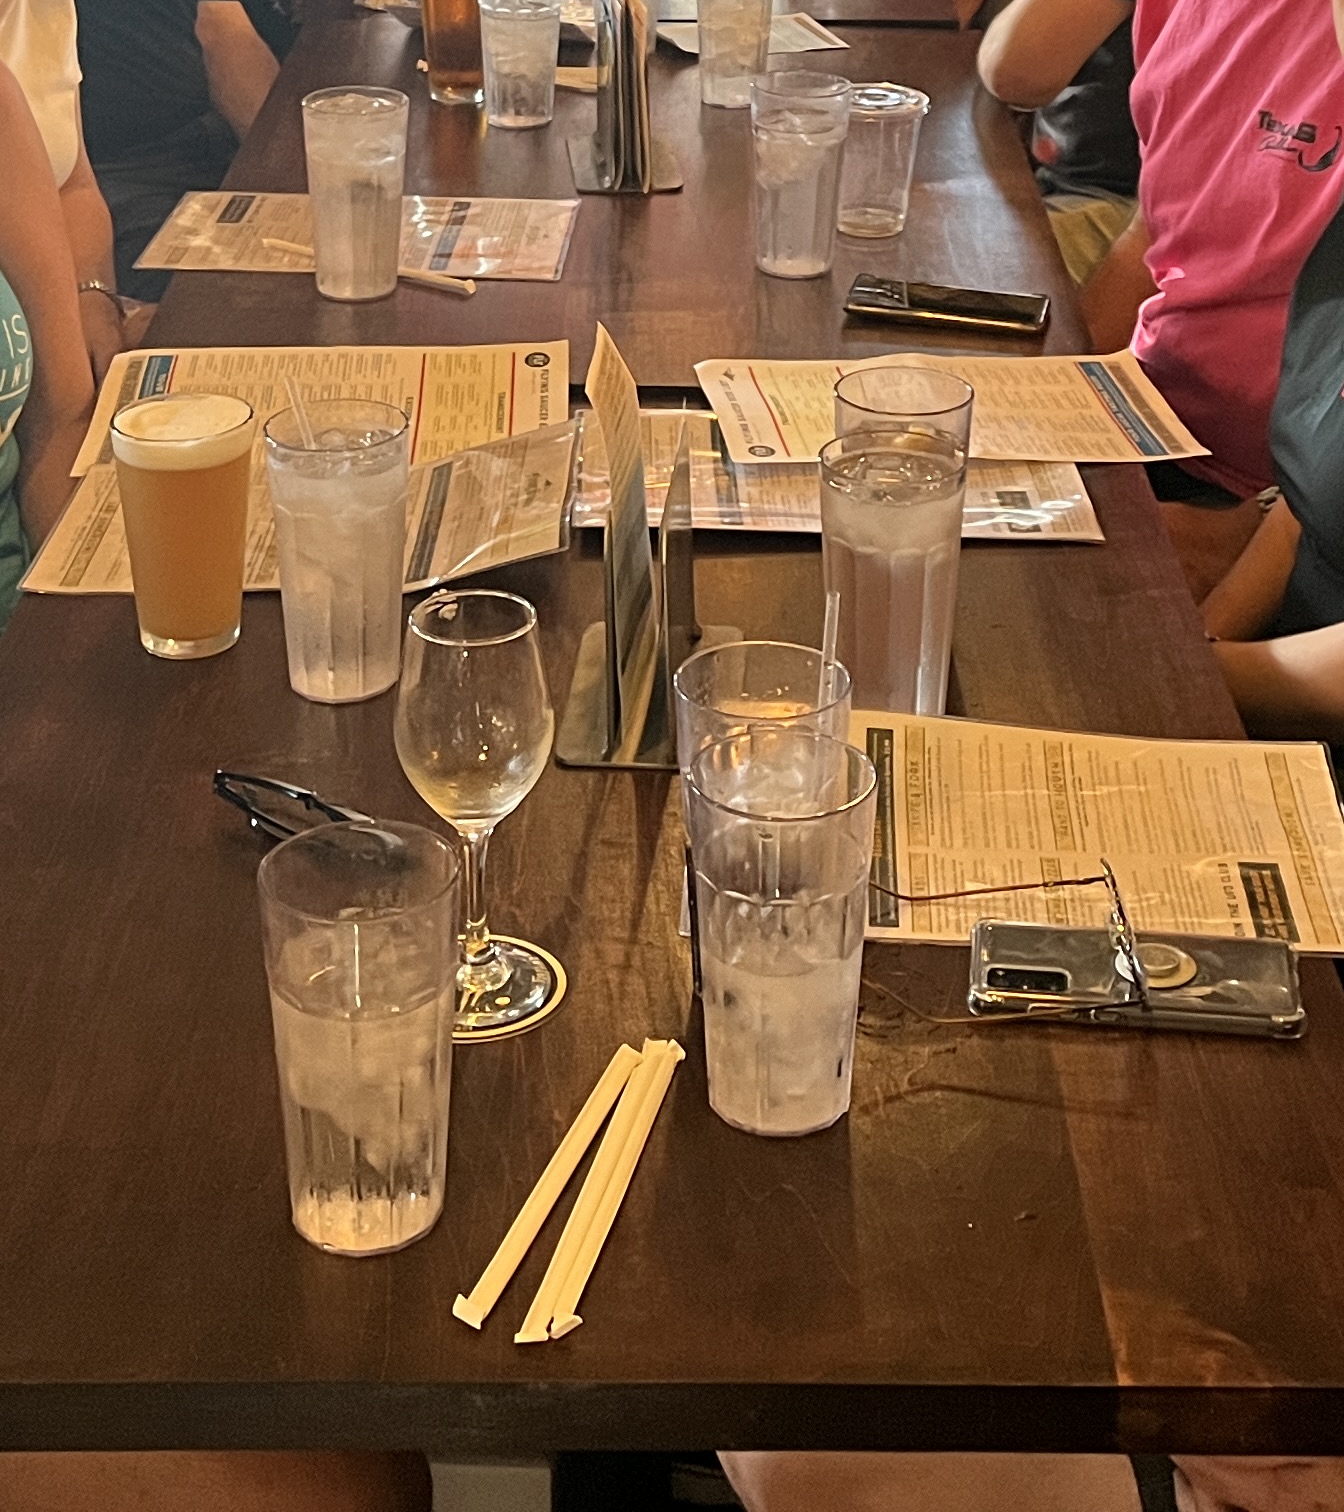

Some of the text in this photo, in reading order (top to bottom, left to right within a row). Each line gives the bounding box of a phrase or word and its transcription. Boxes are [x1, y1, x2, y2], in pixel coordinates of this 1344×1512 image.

[2, 314, 30, 359] IS
[1217, 862, 1246, 937] OIN THE UFO CLUB
